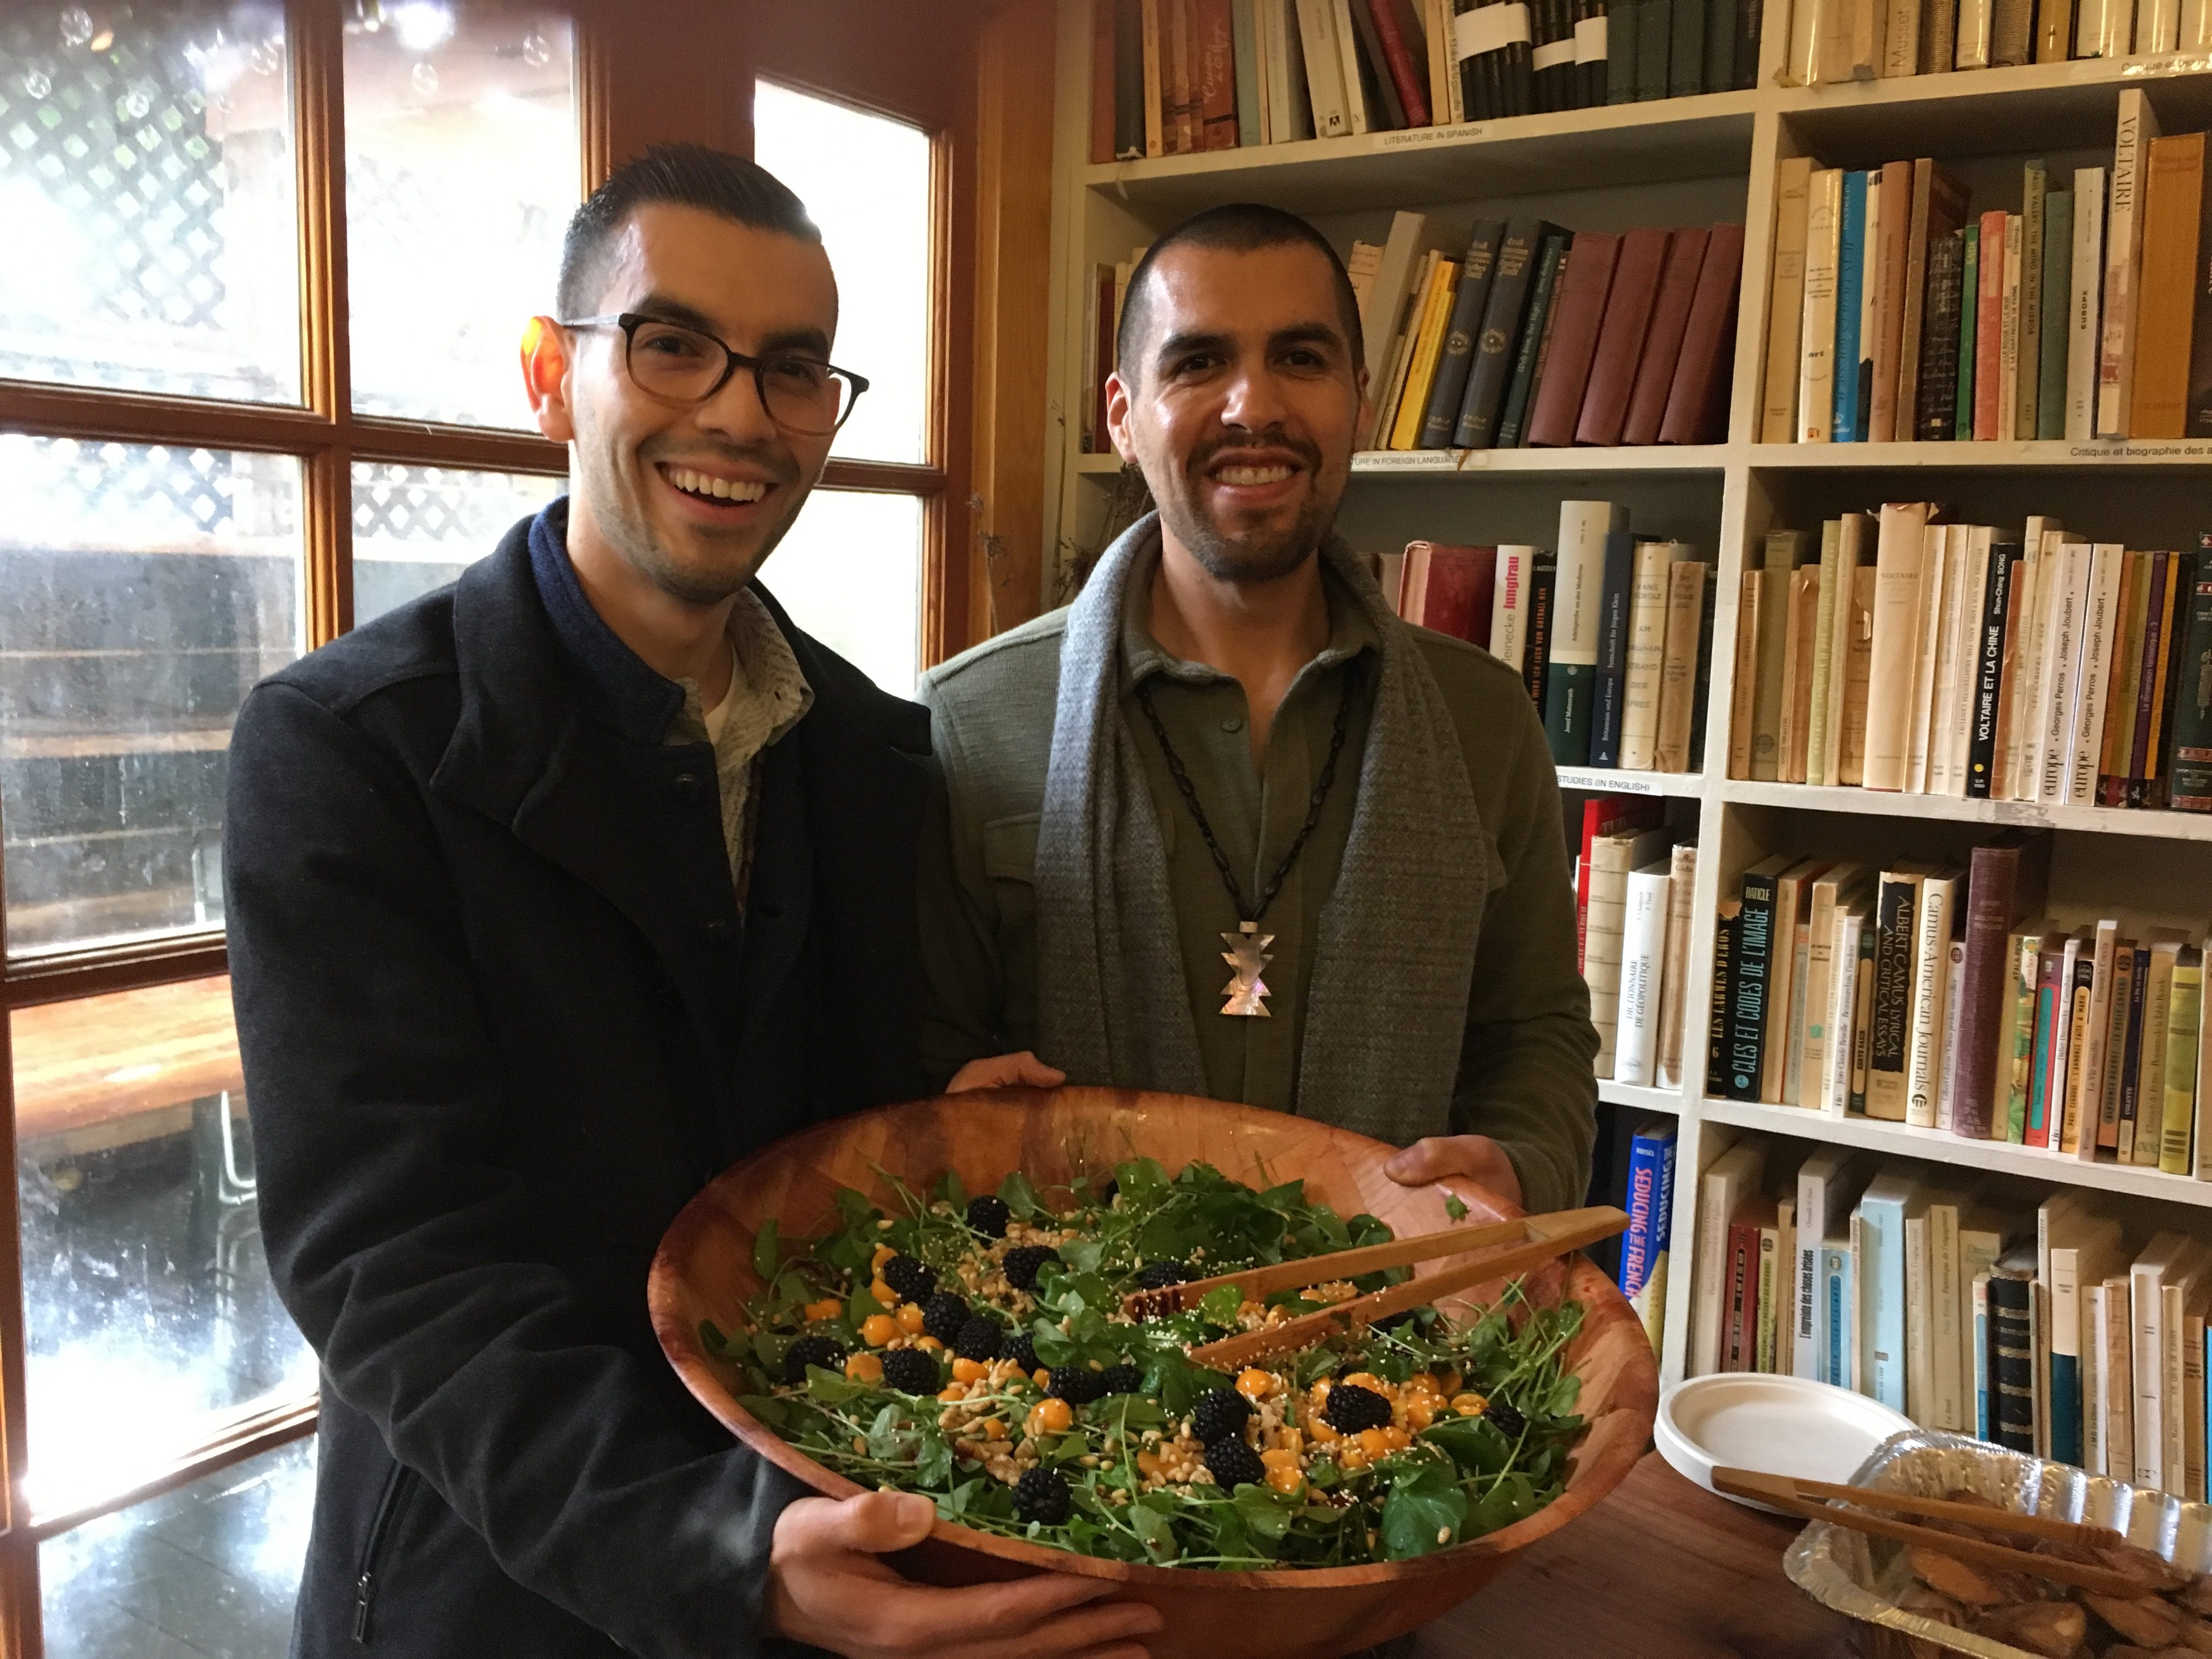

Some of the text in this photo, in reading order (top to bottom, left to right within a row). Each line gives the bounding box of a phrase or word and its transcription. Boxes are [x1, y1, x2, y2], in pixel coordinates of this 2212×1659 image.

[1890, 10, 1909, 66] Musset
[1384, 133, 1433, 145] LITERATURE
[1447, 127, 1482, 138] SPANISH
[2114, 116, 2137, 212] VOLTAIRE
[2031, 172, 2039, 191] PAUL
[2029, 273, 2036, 283] IN
[2070, 447, 2203, 457] Critique et biographie des
[1973, 548, 1983, 575] STUDIES
[1973, 577, 1980, 588] ON
[1993, 554, 2006, 614] Shun-Ching SONG
[1502, 556, 1519, 661] einecke Jungfrau
[1611, 593, 1620, 608] Klein
[1970, 591, 1979, 625] VOLTAIRE
[1571, 610, 1582, 642] Adelsprobe
[1610, 610, 1619, 628] Jürgen
[1607, 639, 1616, 668] Festschrift
[1533, 666, 1541, 677] ICH
[1961, 659, 1972, 702] EIGHTEENTH
[1978, 625, 2000, 741] VOLTAIRE ET LA CHINE
[2142, 632, 2157, 712] La dimension fantastique
[1604, 678, 1613, 698] Europa
[2044, 597, 2072, 796] europe Georges Perros Joseph Joubert
[2073, 598, 2105, 798] europe Georges Perros Joseph Joubert
[1565, 689, 1573, 718] Matzerath
[1601, 712, 1611, 741] Britannien
[1959, 704, 1968, 736] CENTURY
[1557, 775, 1650, 792] STUDIES (IN ENGLISH)
[1888, 895, 1911, 1058] ALBERT CAMUS LYRICAL
[2095, 943, 2108, 1003] Emanuele Coccia
[1625, 960, 1638, 1019] DICTIONNAIRE
[1635, 954, 1651, 1028] DE GÉOPOLITIQUE
[1712, 972, 1727, 1013] LARMES
[1732, 907, 1769, 1073] CLES ET CODES DE L'IMAGE
[1875, 925, 1893, 1057] AND CRITICAL ESSAYS
[2078, 995, 2086, 1013] MARIE
[1711, 1018, 1724, 1039] LES
[1948, 1011, 1956, 1031] perdus
[1835, 1047, 1846, 1084] Jean-Claude
[1914, 1027, 1933, 1091] Journals
[2072, 1044, 2081, 1075] L'ANNONCE
[2087, 1069, 2096, 1080] Vie
[2087, 1083, 2095, 1091] La
[1942, 1080, 1950, 1101] Gilbert
[2069, 1085, 2077, 1108] CLAUDEL
[1656, 1160, 1672, 1242] SEDUCING
[1624, 1166, 1652, 1299] SEDUCING THE FRENCH
[1942, 1211, 1950, 1250] l'engagement
[1801, 1272, 1813, 1294] choses
[1799, 1294, 1812, 1305] des
[1798, 1305, 1813, 1339] l'empreinte
[2170, 1330, 2178, 1352] CROIS
[2170, 1354, 2177, 1363] JE
[2171, 1386, 2177, 1395] CE
[1945, 1416, 1951, 1424] Le
